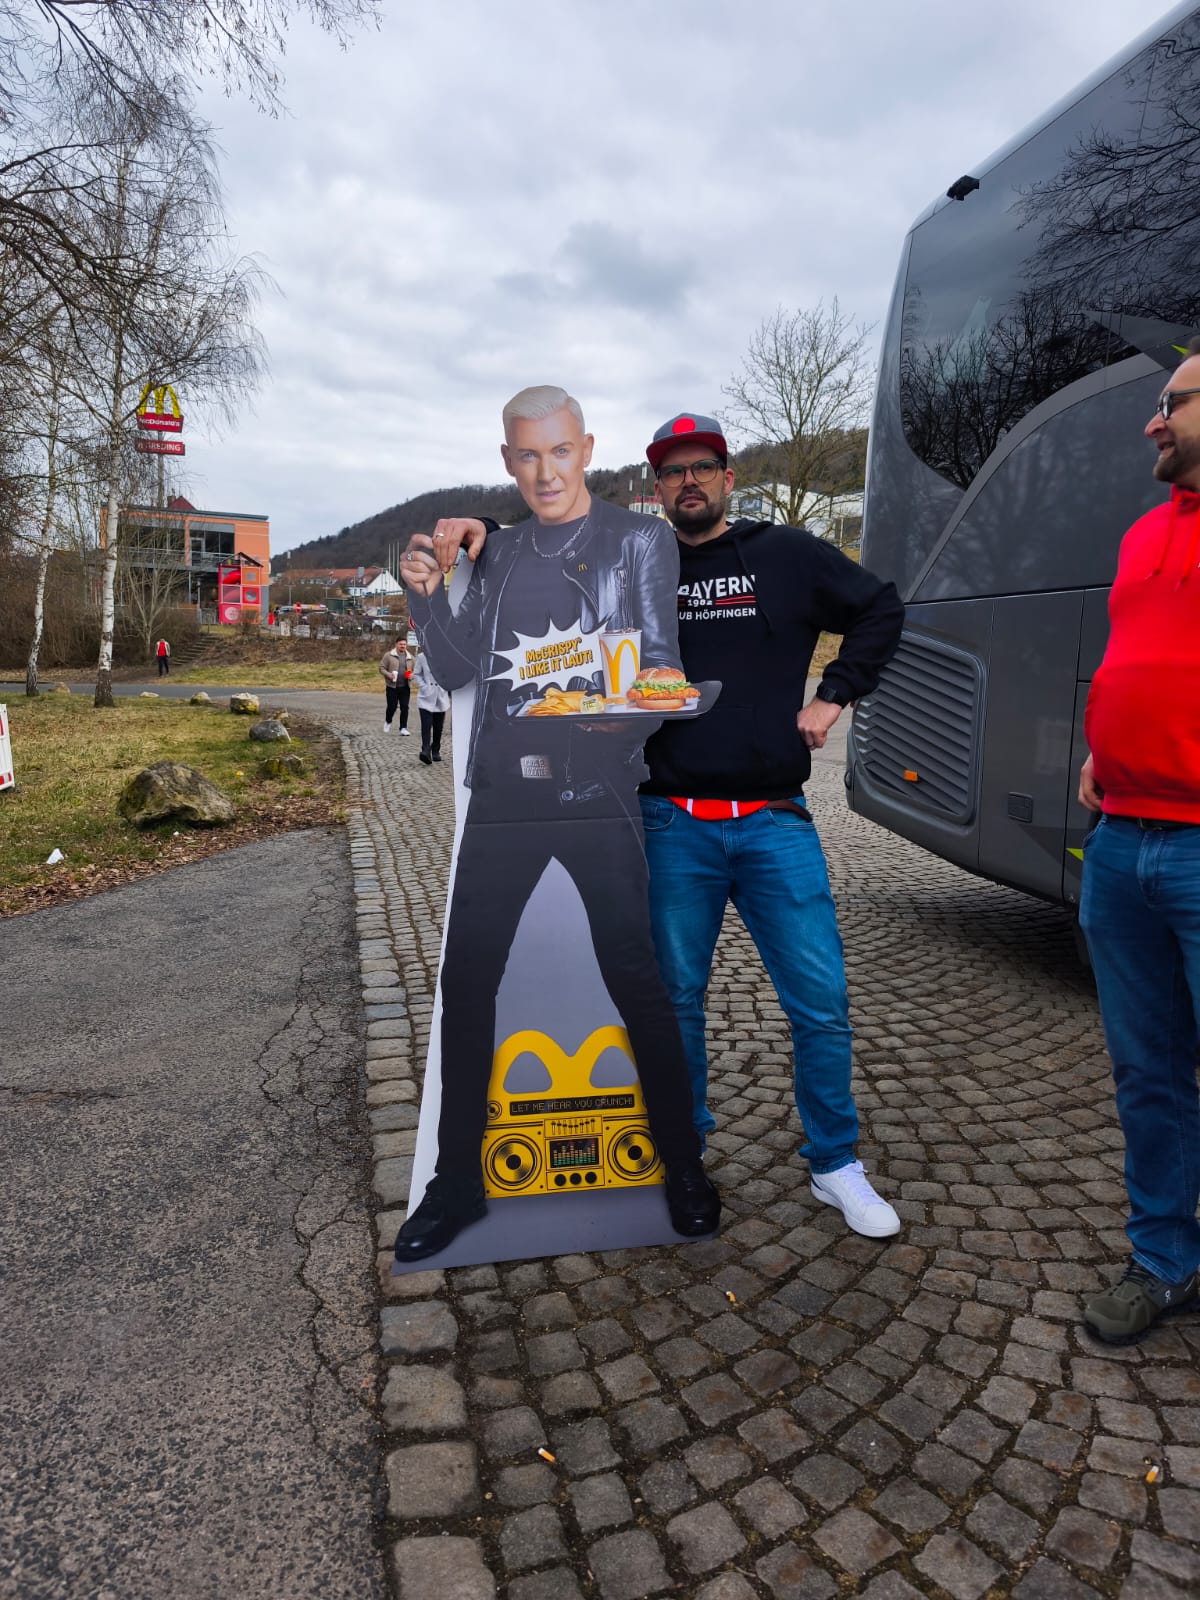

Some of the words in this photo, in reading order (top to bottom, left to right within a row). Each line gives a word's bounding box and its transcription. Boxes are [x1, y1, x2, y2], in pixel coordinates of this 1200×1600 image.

[695, 607, 757, 620] HÖPFINGEN
[518, 667, 525, 680] I
[526, 661, 550, 679] LIKE
[550, 657, 561, 672] IT
[563, 649, 594, 669] LAUT!
[511, 1104, 529, 1113] LET
[532, 1102, 545, 1111] ME
[547, 1101, 572, 1111] HEAR
[574, 1099, 593, 1108] YOU
